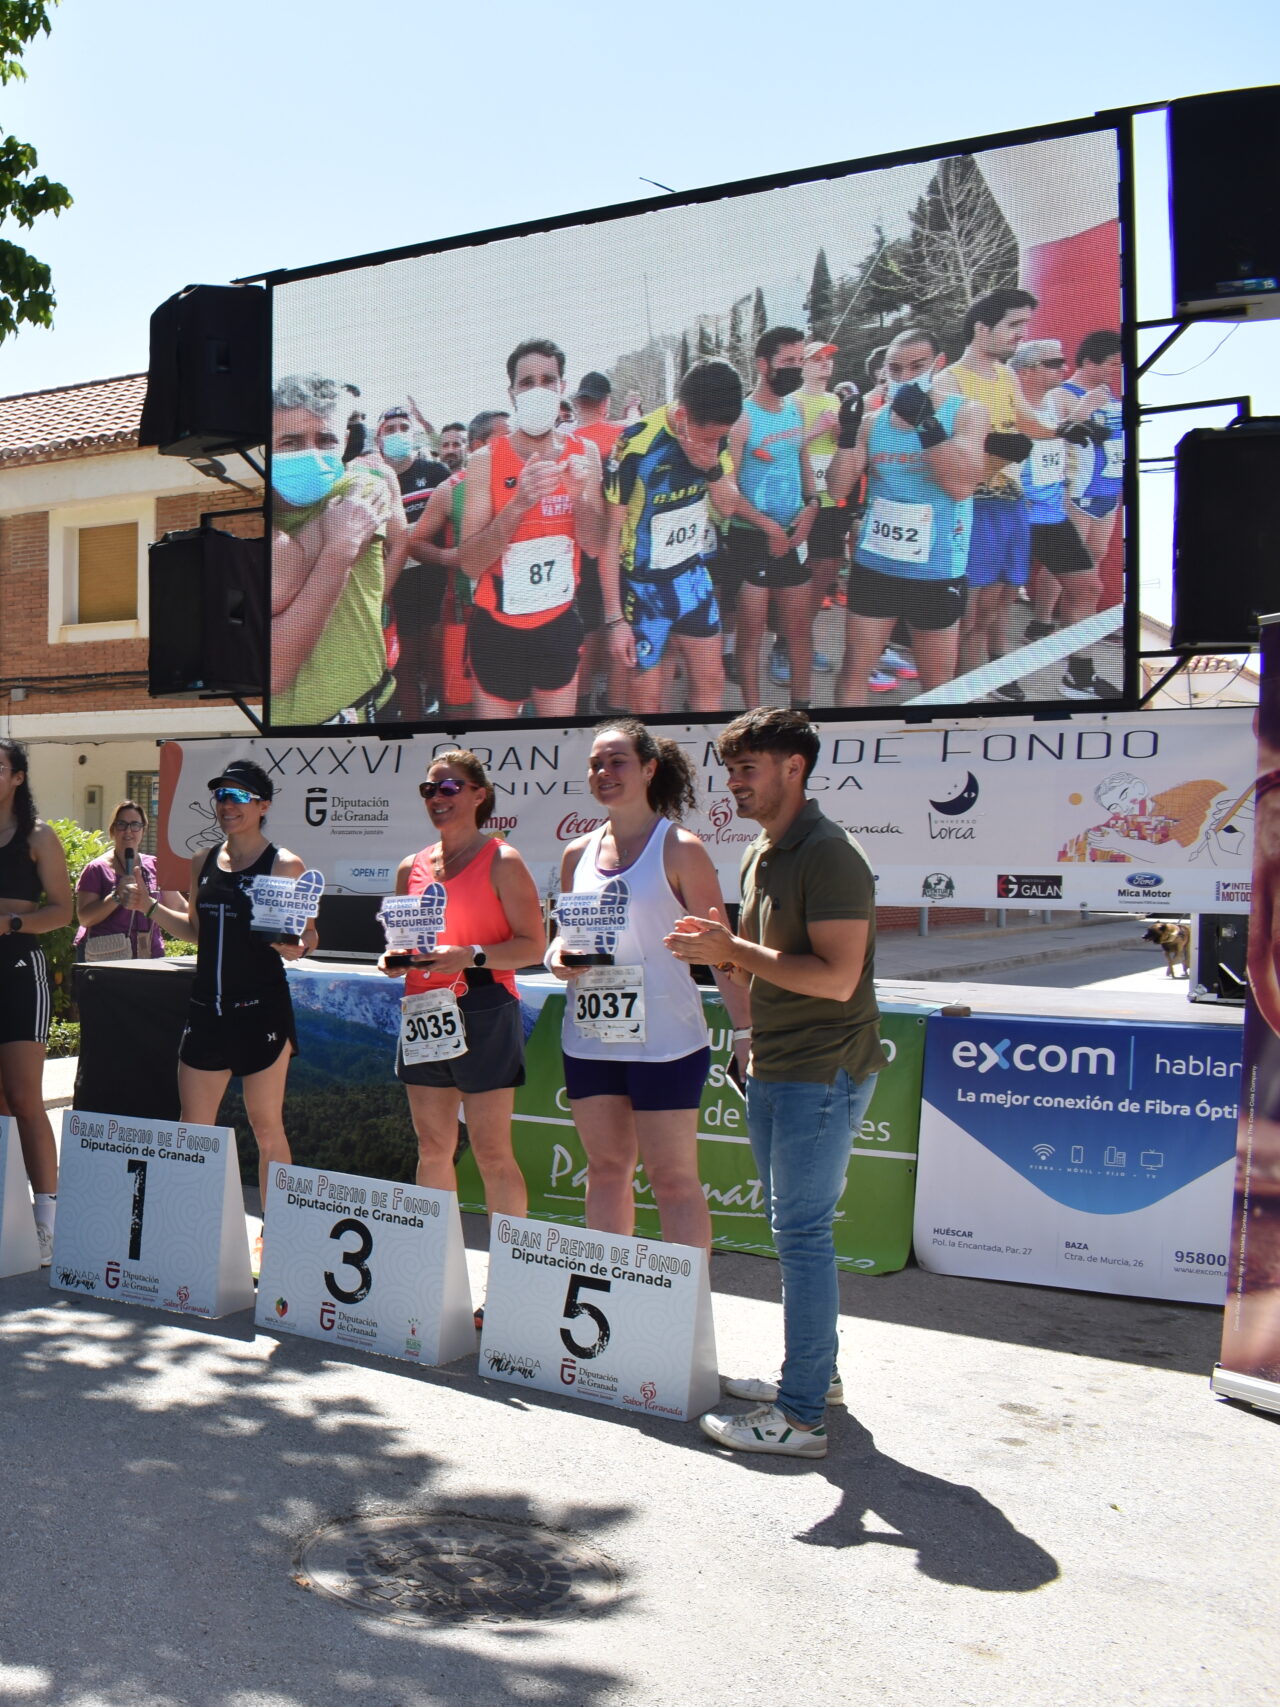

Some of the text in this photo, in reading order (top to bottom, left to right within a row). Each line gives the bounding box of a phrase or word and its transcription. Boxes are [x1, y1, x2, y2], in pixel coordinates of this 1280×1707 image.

[665, 523, 698, 548] 403
[872, 520, 919, 544] 3052
[528, 560, 556, 586] 87
[266, 745, 402, 775] XXXVI
[832, 738, 904, 764] DE
[942, 730, 1159, 762] FONDO
[331, 796, 390, 808] Diputación
[331, 811, 389, 822] de Granada
[928, 812, 977, 840] Lorca
[1132, 874, 1156, 886] Ford
[259, 888, 318, 902] CORDERO
[1021, 884, 1062, 897] GALAN
[1118, 889, 1172, 898] Mica Motor
[257, 898, 317, 911] SEGUREÑO
[564, 906, 625, 916] CORDERO
[388, 908, 442, 918] CORDERO
[564, 914, 625, 926] SEGUREÑO
[388, 916, 443, 928] SEGUREÑO
[234, 1000, 259, 1008] POLAR
[576, 992, 638, 1020] 3037
[406, 1011, 456, 1042] 3035
[952, 1038, 1116, 1076] excom
[958, 1088, 1239, 1122] La mejor conexión de Fibra Ópti
[704, 1099, 740, 1128] de
[70, 1115, 220, 1154] GRAN PREMIO DE FONDO
[80, 1138, 206, 1164] Diputación de Granada
[1030, 1164, 1054, 1172] FIBRA
[1067, 1166, 1094, 1175] MÓVIL
[276, 1168, 440, 1218] GRAN PREMIO DE FONDO
[127, 1158, 148, 1260] 1
[287, 1193, 424, 1228] Diputación de Granada
[933, 1226, 974, 1238] HUÉSCAR
[498, 1220, 692, 1276] GRAN PREMIO DE FONDO
[932, 1238, 1032, 1256] Pol. la Encantada, Par. 27
[1064, 1240, 1089, 1250] BAZA
[324, 1218, 374, 1304] 3
[1064, 1252, 1144, 1268] Ctra. de Murcia, 26
[1175, 1250, 1228, 1266] 95800
[512, 1248, 672, 1288] Diputación de Granada
[1174, 1266, 1230, 1278] www.excom.e
[122, 1270, 160, 1284] Diputación
[131, 1282, 159, 1294] Granada
[338, 1312, 378, 1328] Diputación
[560, 1274, 611, 1360] 5
[346, 1325, 378, 1338] Granada
[484, 1348, 542, 1370] GRANADA
[578, 1368, 618, 1384] Diputación
[588, 1380, 618, 1392] Granada
[648, 1400, 683, 1416] Granada
